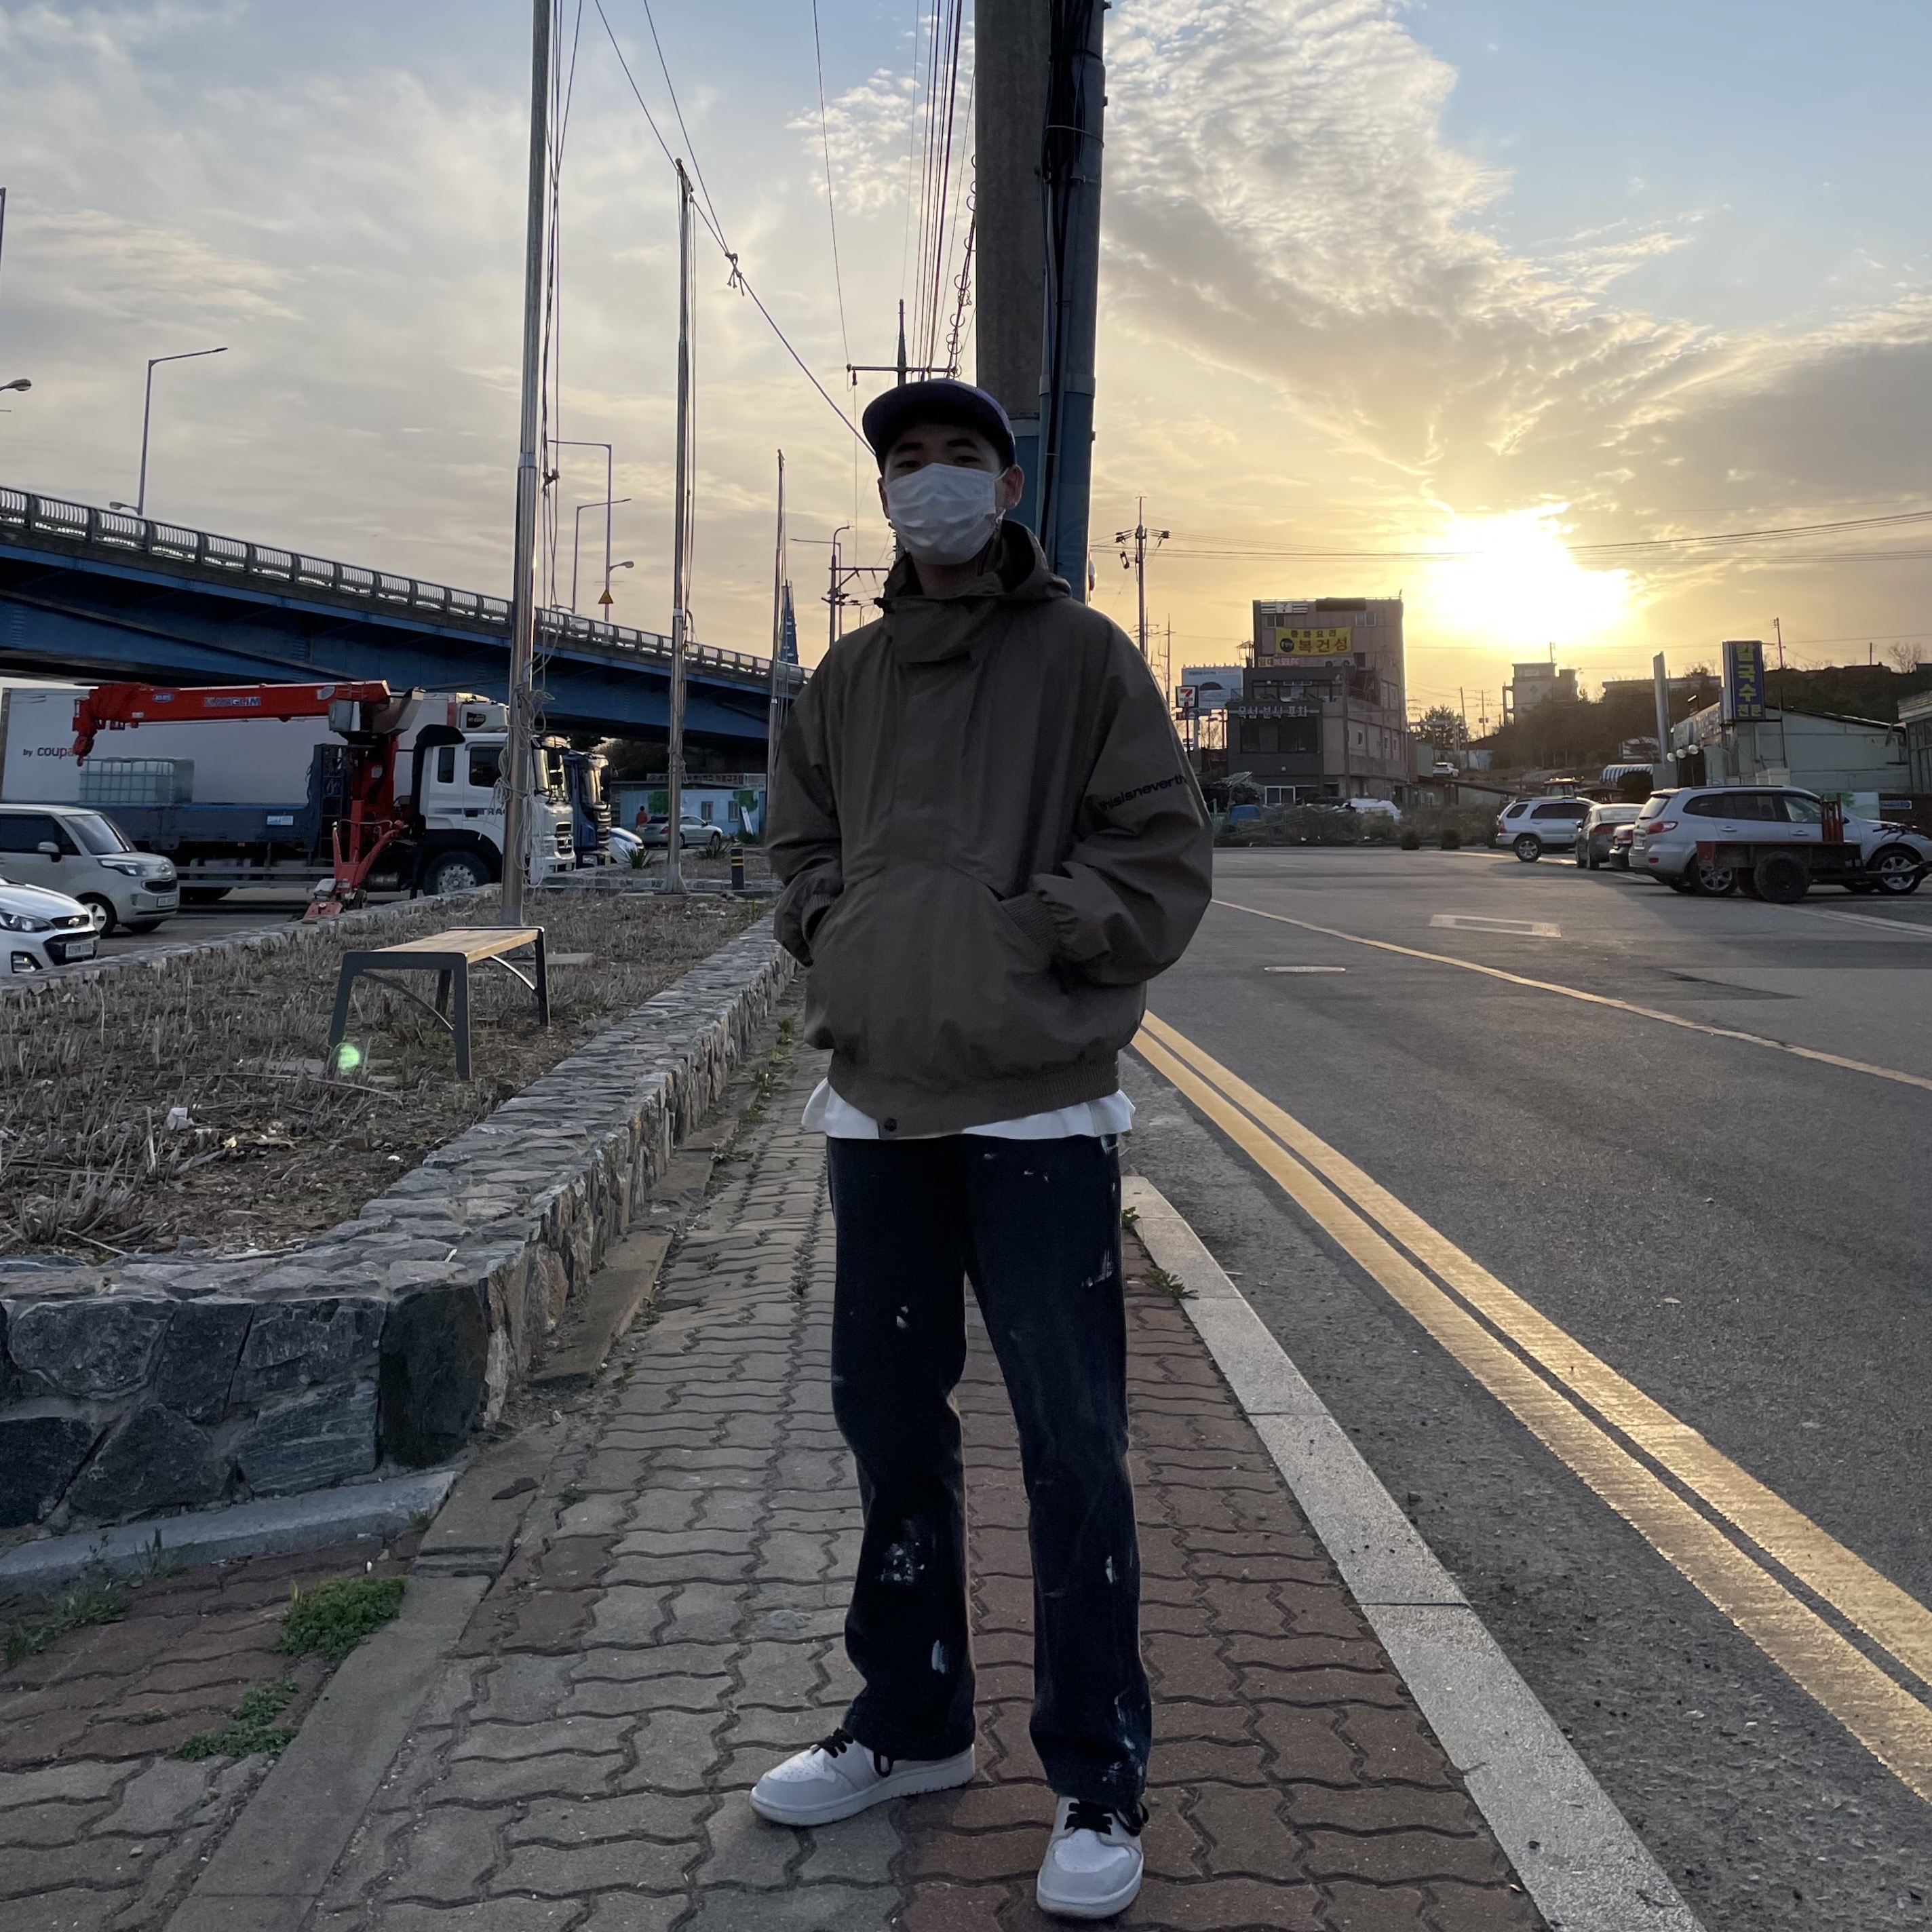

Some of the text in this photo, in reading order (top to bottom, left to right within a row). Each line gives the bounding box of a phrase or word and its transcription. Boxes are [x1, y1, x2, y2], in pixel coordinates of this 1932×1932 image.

[1299, 637, 1347, 653] 복건성
[1736, 644, 1757, 702] 칼국수
[1263, 706, 1282, 719] 분식
[1288, 706, 1307, 717] 포차
[23, 749, 33, 757] by
